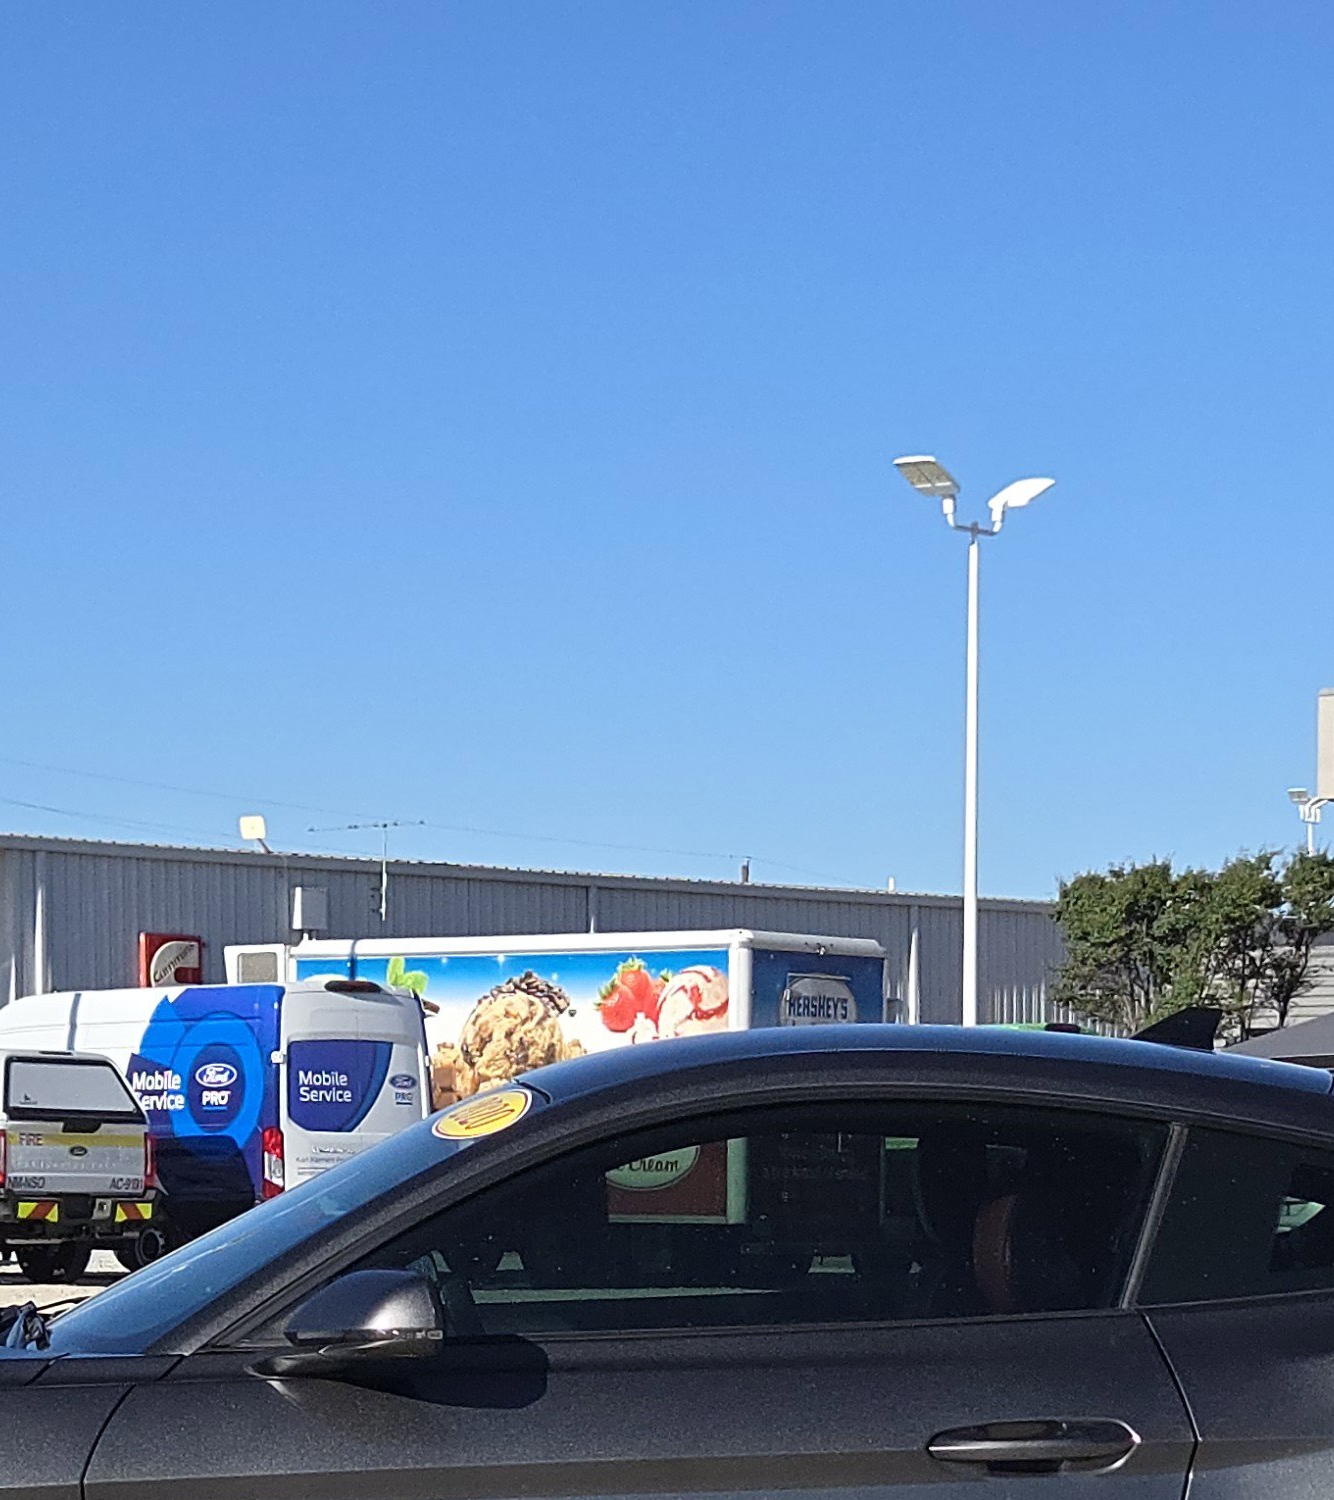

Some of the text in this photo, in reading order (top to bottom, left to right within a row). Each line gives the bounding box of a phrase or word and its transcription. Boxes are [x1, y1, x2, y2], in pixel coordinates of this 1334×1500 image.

[132, 1070, 182, 1090] Mobile
[298, 1070, 348, 1086] Mobile
[202, 1091, 229, 1106] PRO
[299, 1087, 352, 1102] Service
[19, 1133, 43, 1146] FIRE
